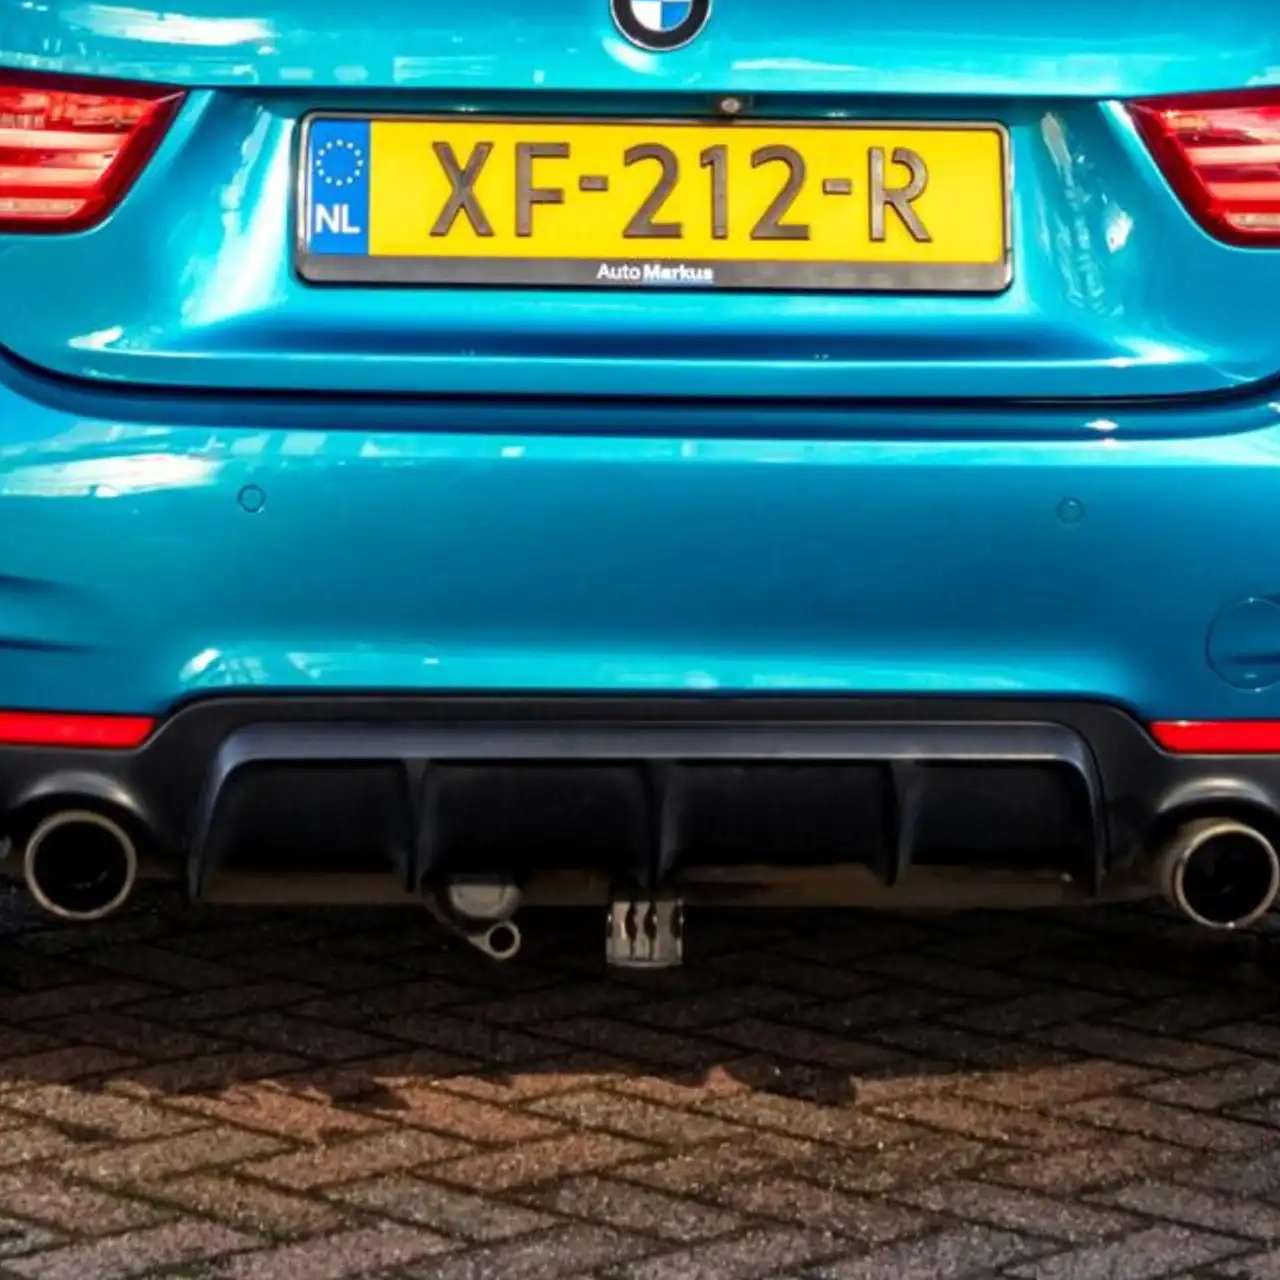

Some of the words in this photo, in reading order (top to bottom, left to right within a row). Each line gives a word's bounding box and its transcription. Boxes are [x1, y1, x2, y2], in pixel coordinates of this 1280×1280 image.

[429, 141, 933, 243] XF-212-R
[315, 203, 360, 234] NL
[596, 263, 640, 280] Auto
[642, 263, 714, 281] Markus
